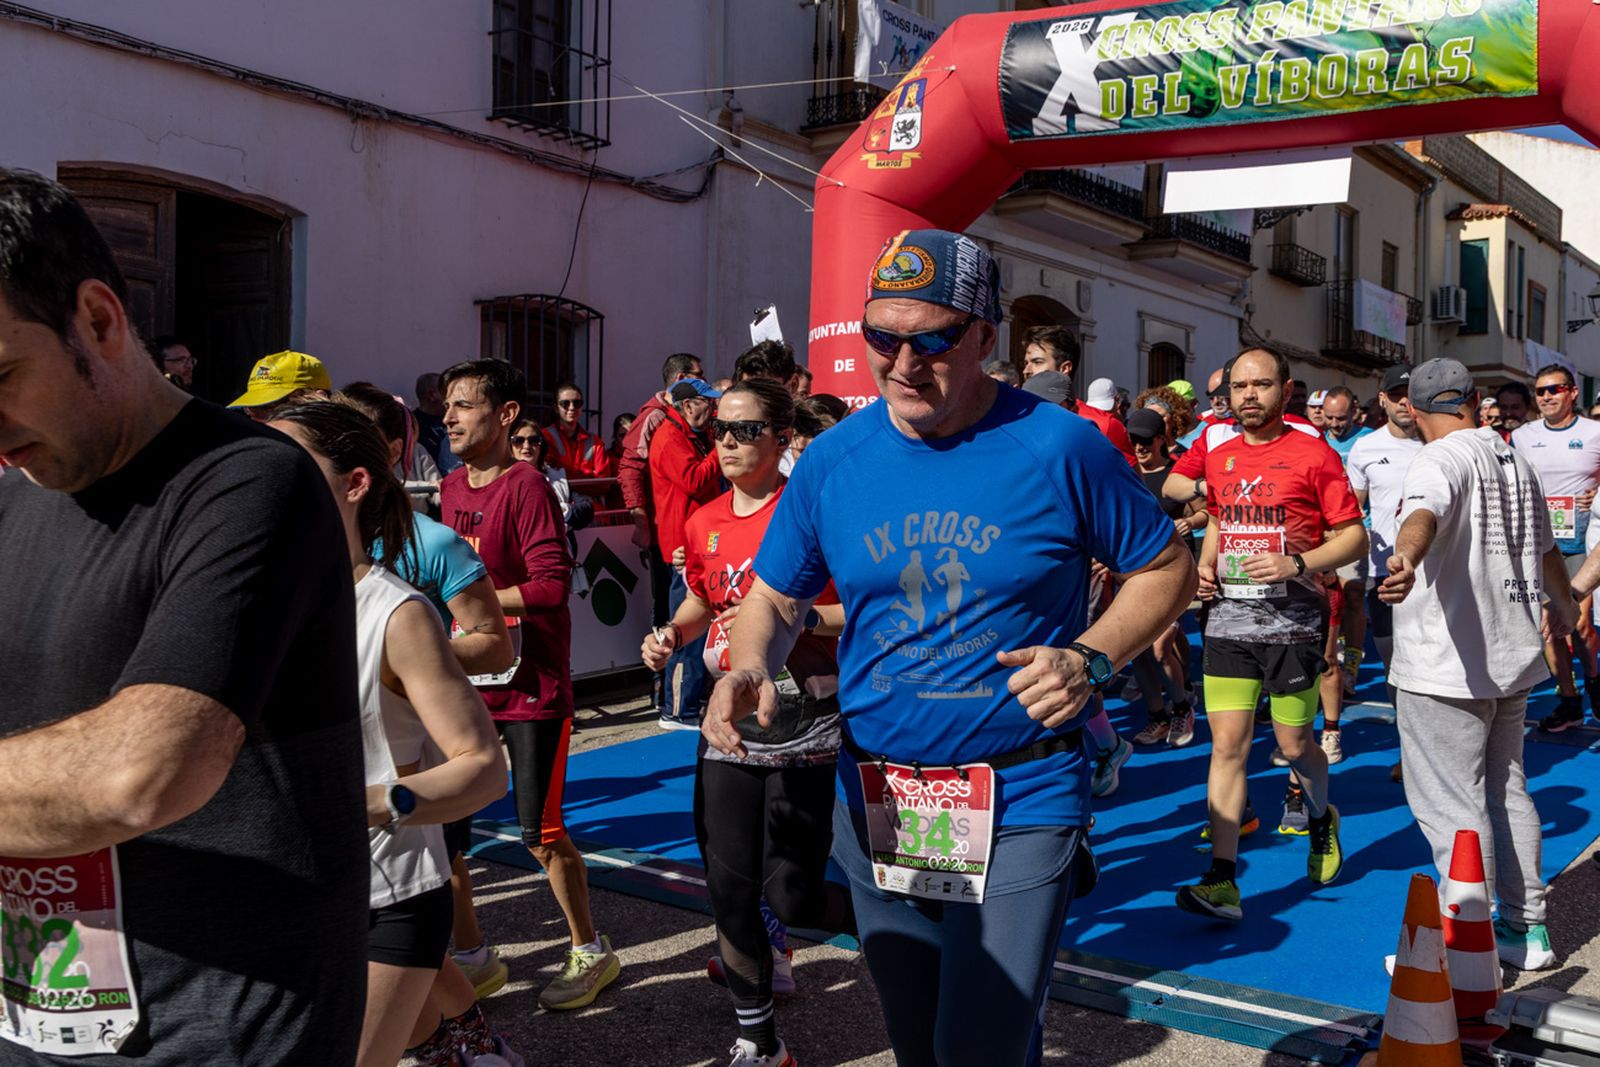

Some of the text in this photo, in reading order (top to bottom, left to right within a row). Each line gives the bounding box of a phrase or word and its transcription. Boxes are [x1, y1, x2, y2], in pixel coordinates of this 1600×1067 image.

[882, 9, 911, 33] CROSS
[1051, 20, 1092, 35] 2026
[1095, 7, 1239, 62] CROSS
[1032, 12, 1138, 136] X
[1098, 36, 1475, 121] DEL VÍBORAS
[834, 358, 856, 373] DE
[839, 395, 879, 409] TOS
[1221, 482, 1276, 497] CROSS
[453, 510, 484, 535] TOP
[1220, 504, 1287, 524] PANTANO
[864, 511, 1001, 564] IX CROSS
[1224, 535, 1270, 549] X CROSS
[919, 647, 943, 661] DEL
[943, 628, 999, 660] VÍBORAS
[901, 778, 972, 798] CROSS
[882, 793, 955, 814] PANTANO
[899, 808, 955, 858] 34
[56, 901, 80, 914] DEL
[98, 992, 129, 1005] RON
